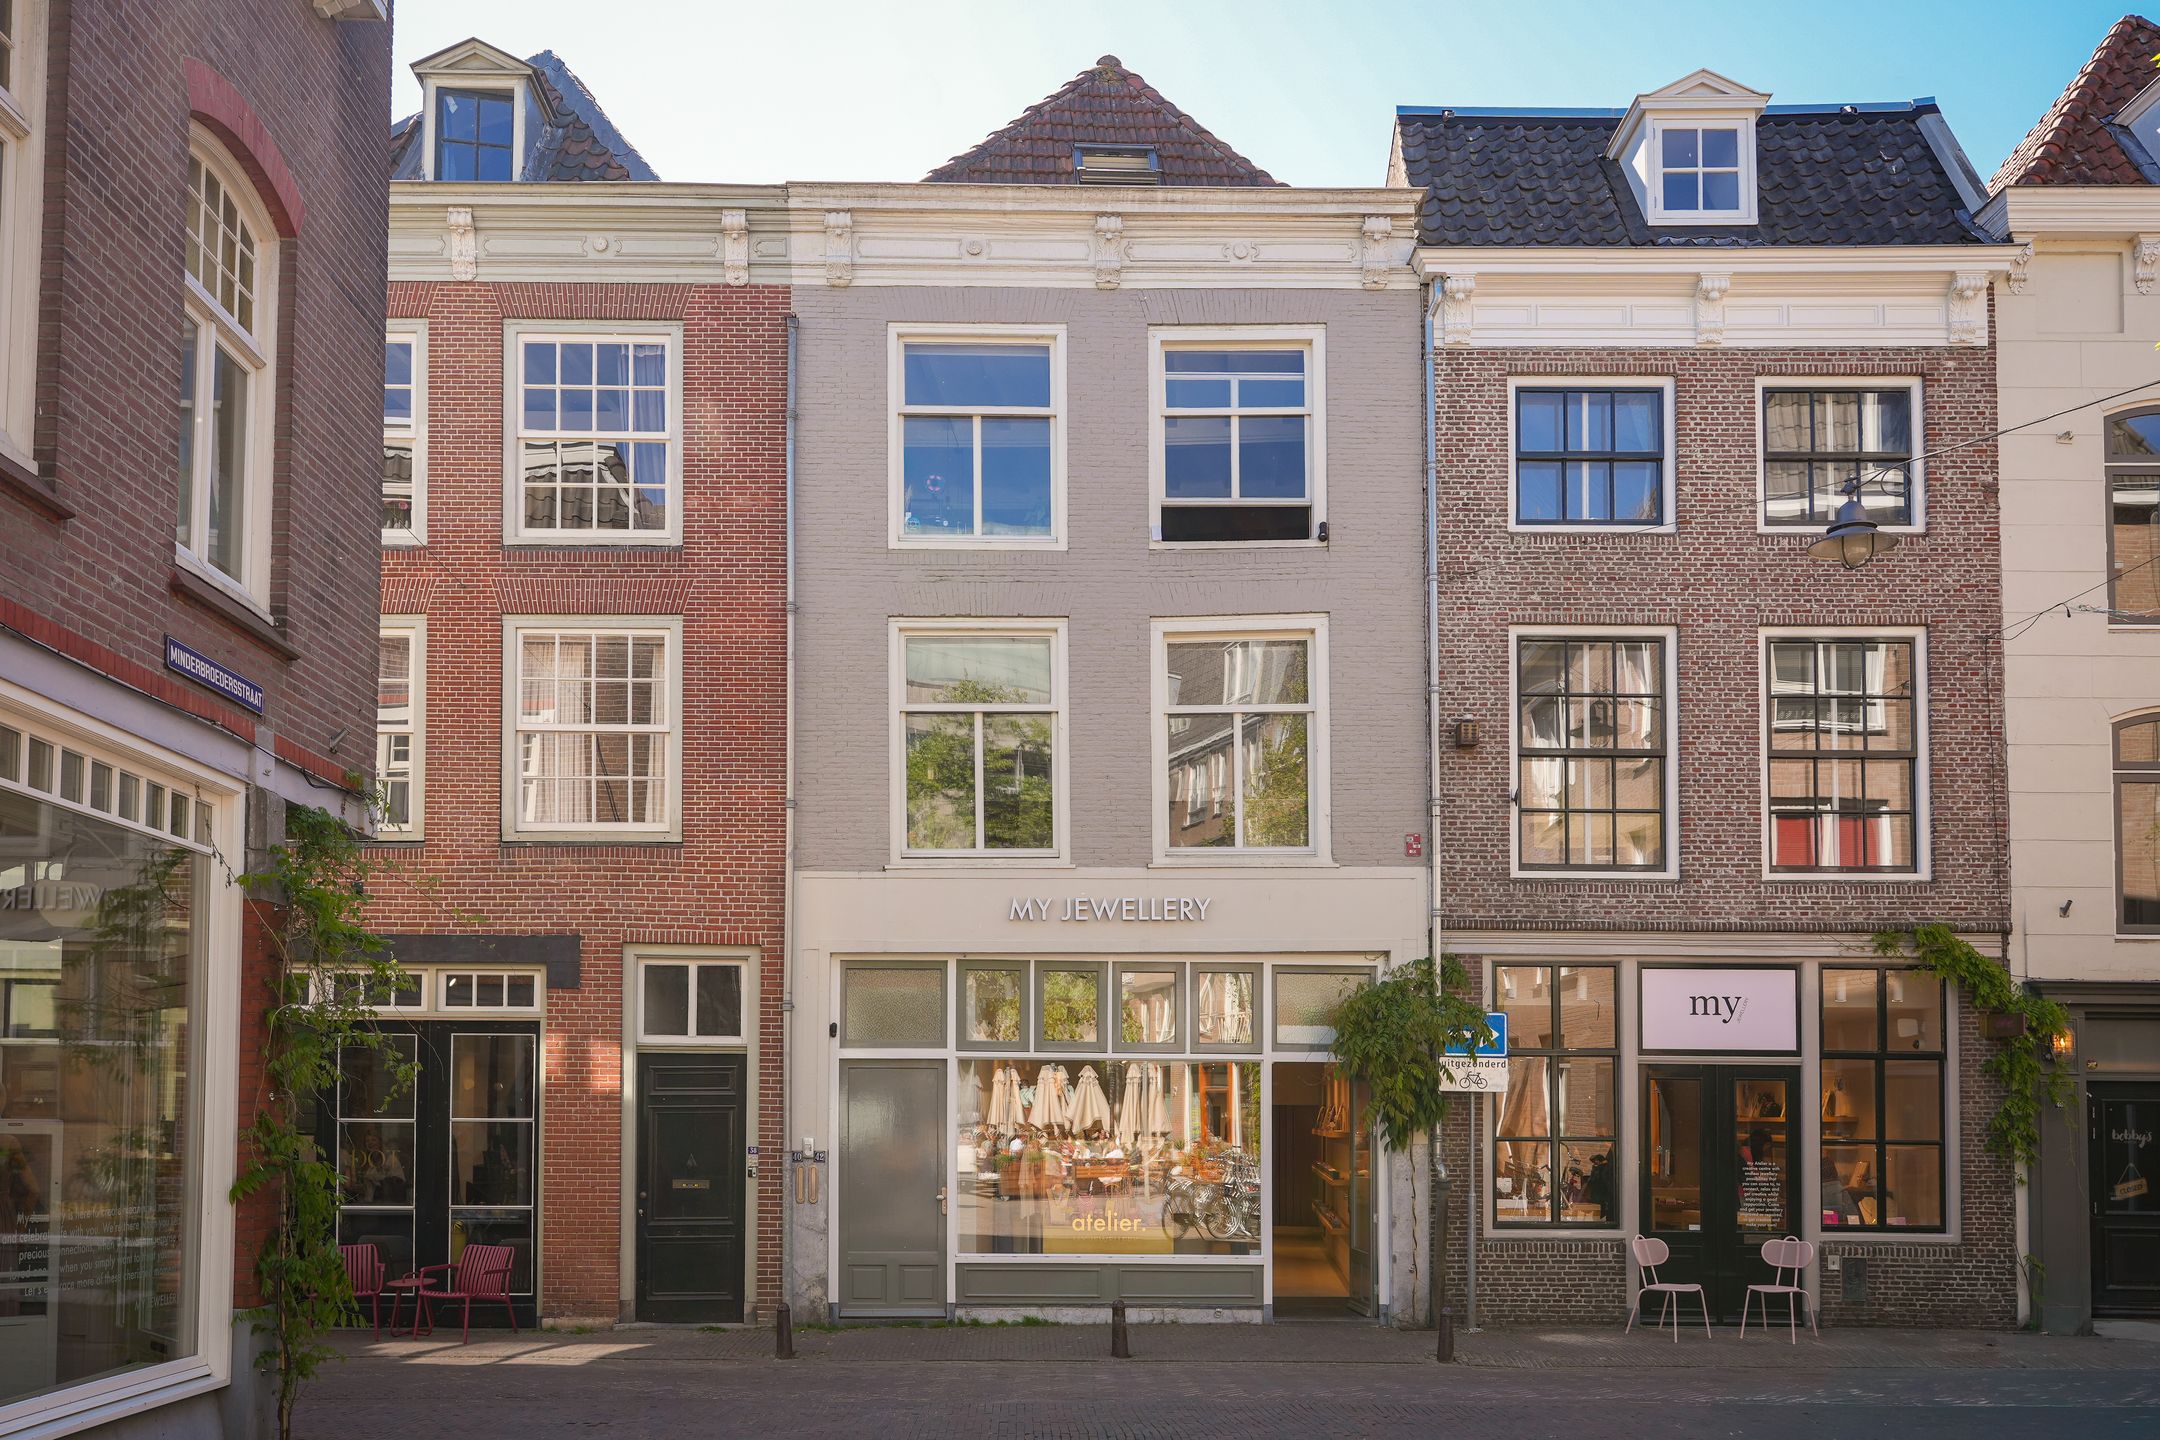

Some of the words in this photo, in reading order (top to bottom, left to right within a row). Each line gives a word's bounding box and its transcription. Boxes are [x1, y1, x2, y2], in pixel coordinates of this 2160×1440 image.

[169, 644, 263, 708] MINDERBROEDERSSTRAAT
[1008, 897, 1053, 921] MY
[1060, 897, 1212, 921] JEWELLERY
[1689, 995, 1742, 1024] my
[1441, 1059, 1506, 1070] uitgezonderd
[2111, 1128, 2153, 1149] bobby's
[792, 1152, 802, 1161] 40
[815, 1152, 825, 1161] 42
[1072, 1209, 1146, 1232] atelier.
